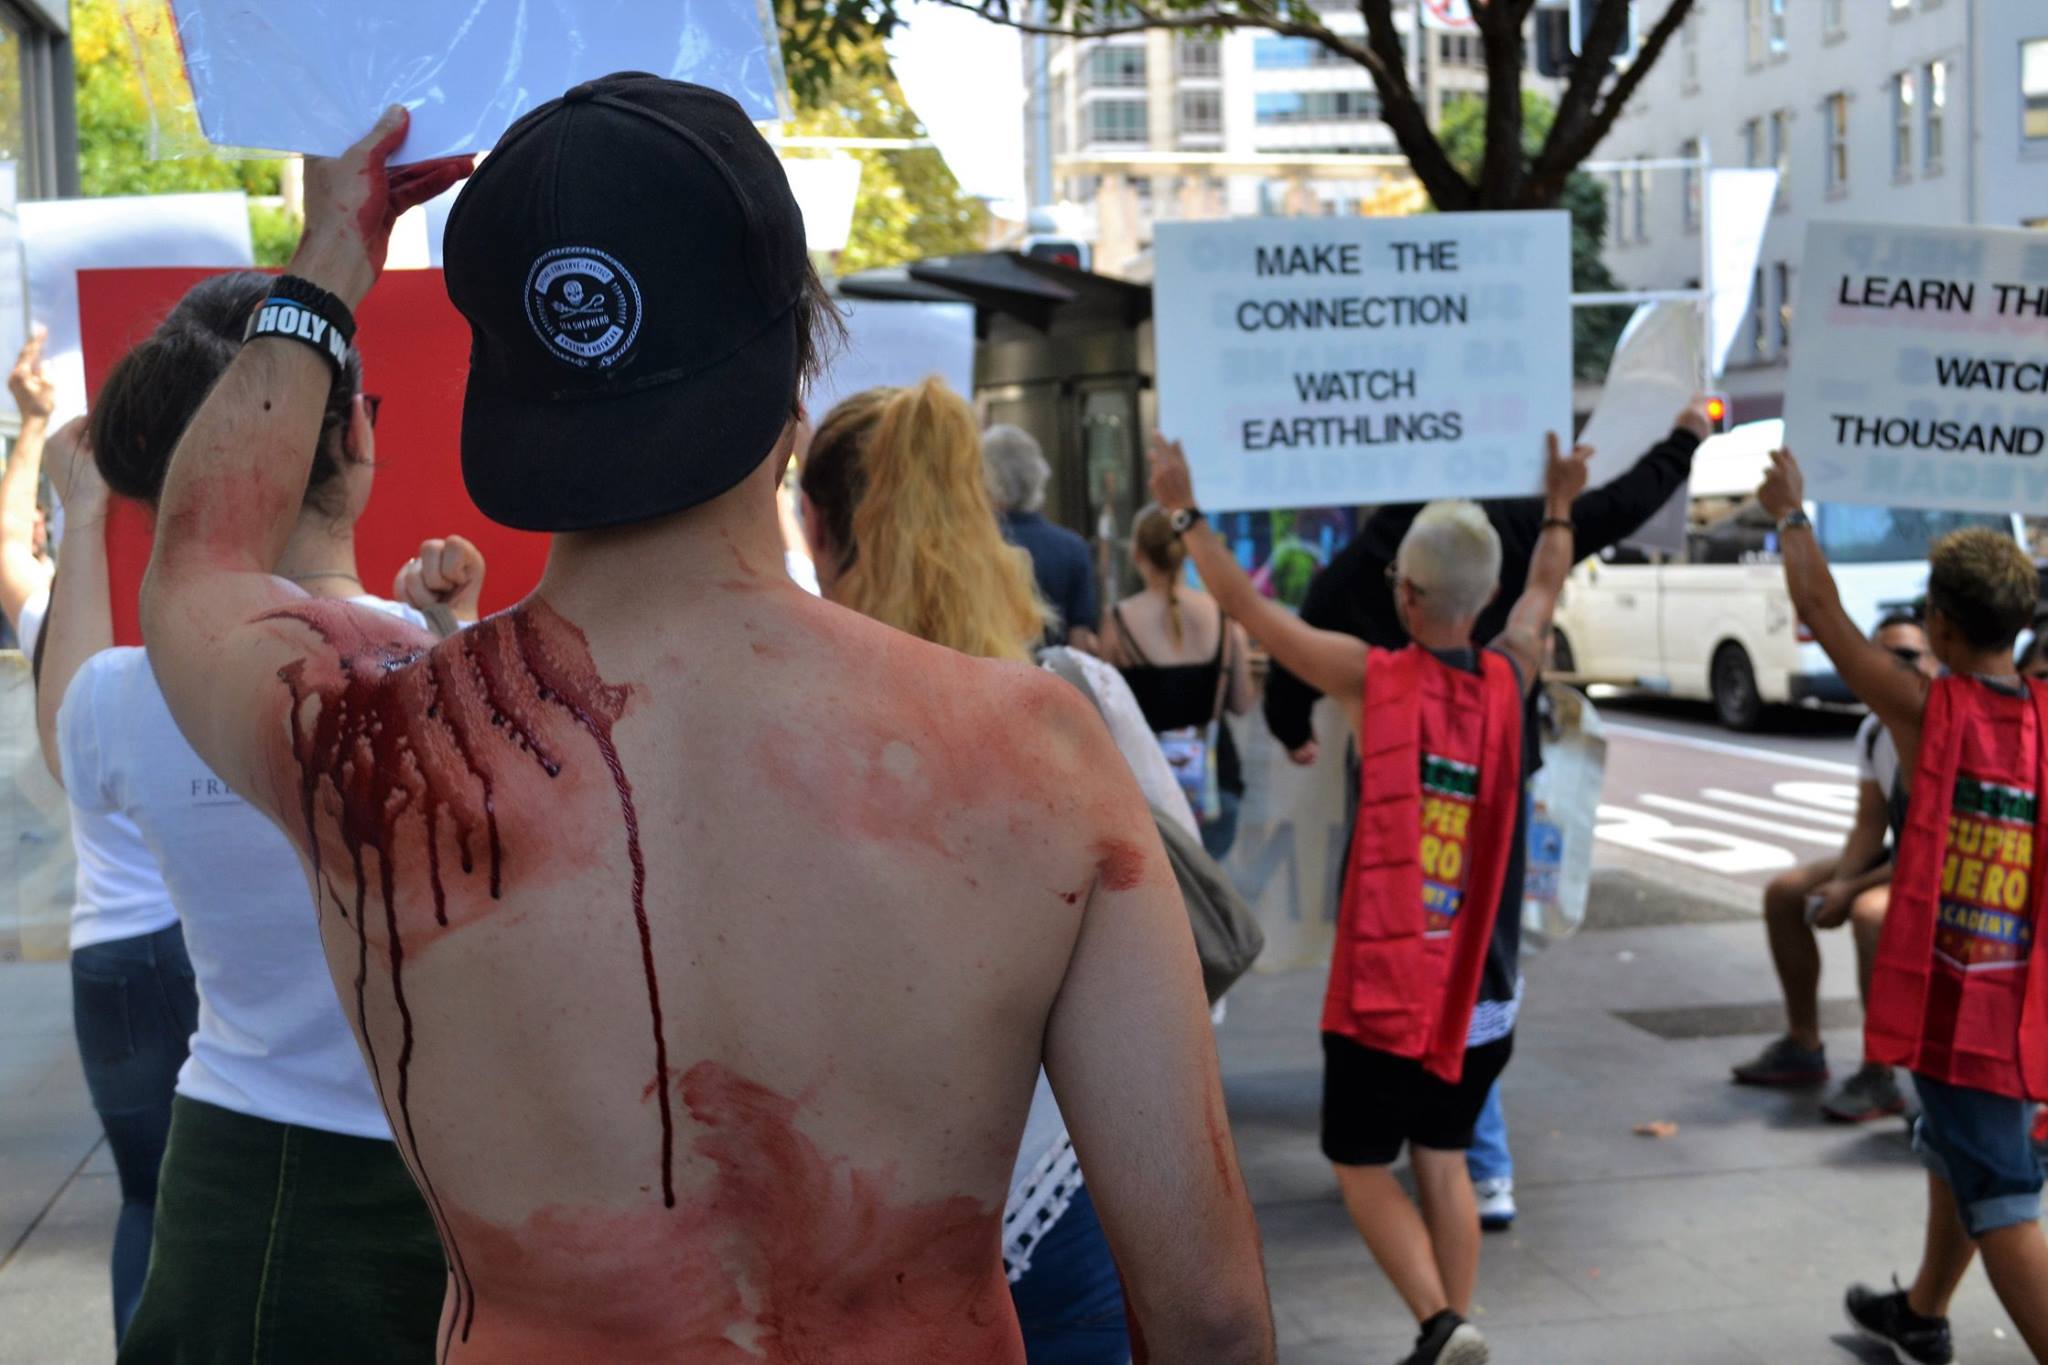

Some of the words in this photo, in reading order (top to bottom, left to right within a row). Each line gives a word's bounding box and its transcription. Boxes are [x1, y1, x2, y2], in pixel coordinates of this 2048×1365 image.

[1256, 246, 1360, 277] MAKE
[1390, 242, 1459, 271] THE
[1838, 275, 1975, 313] LEARN
[256, 305, 329, 344] HOLY
[1236, 295, 1468, 332] CONNECTION
[1296, 369, 1416, 401] WATCH
[1242, 412, 1462, 450] EARTHLINGS
[1831, 414, 2045, 456] THOUSAND
[1938, 903, 2015, 938] CADEMY
